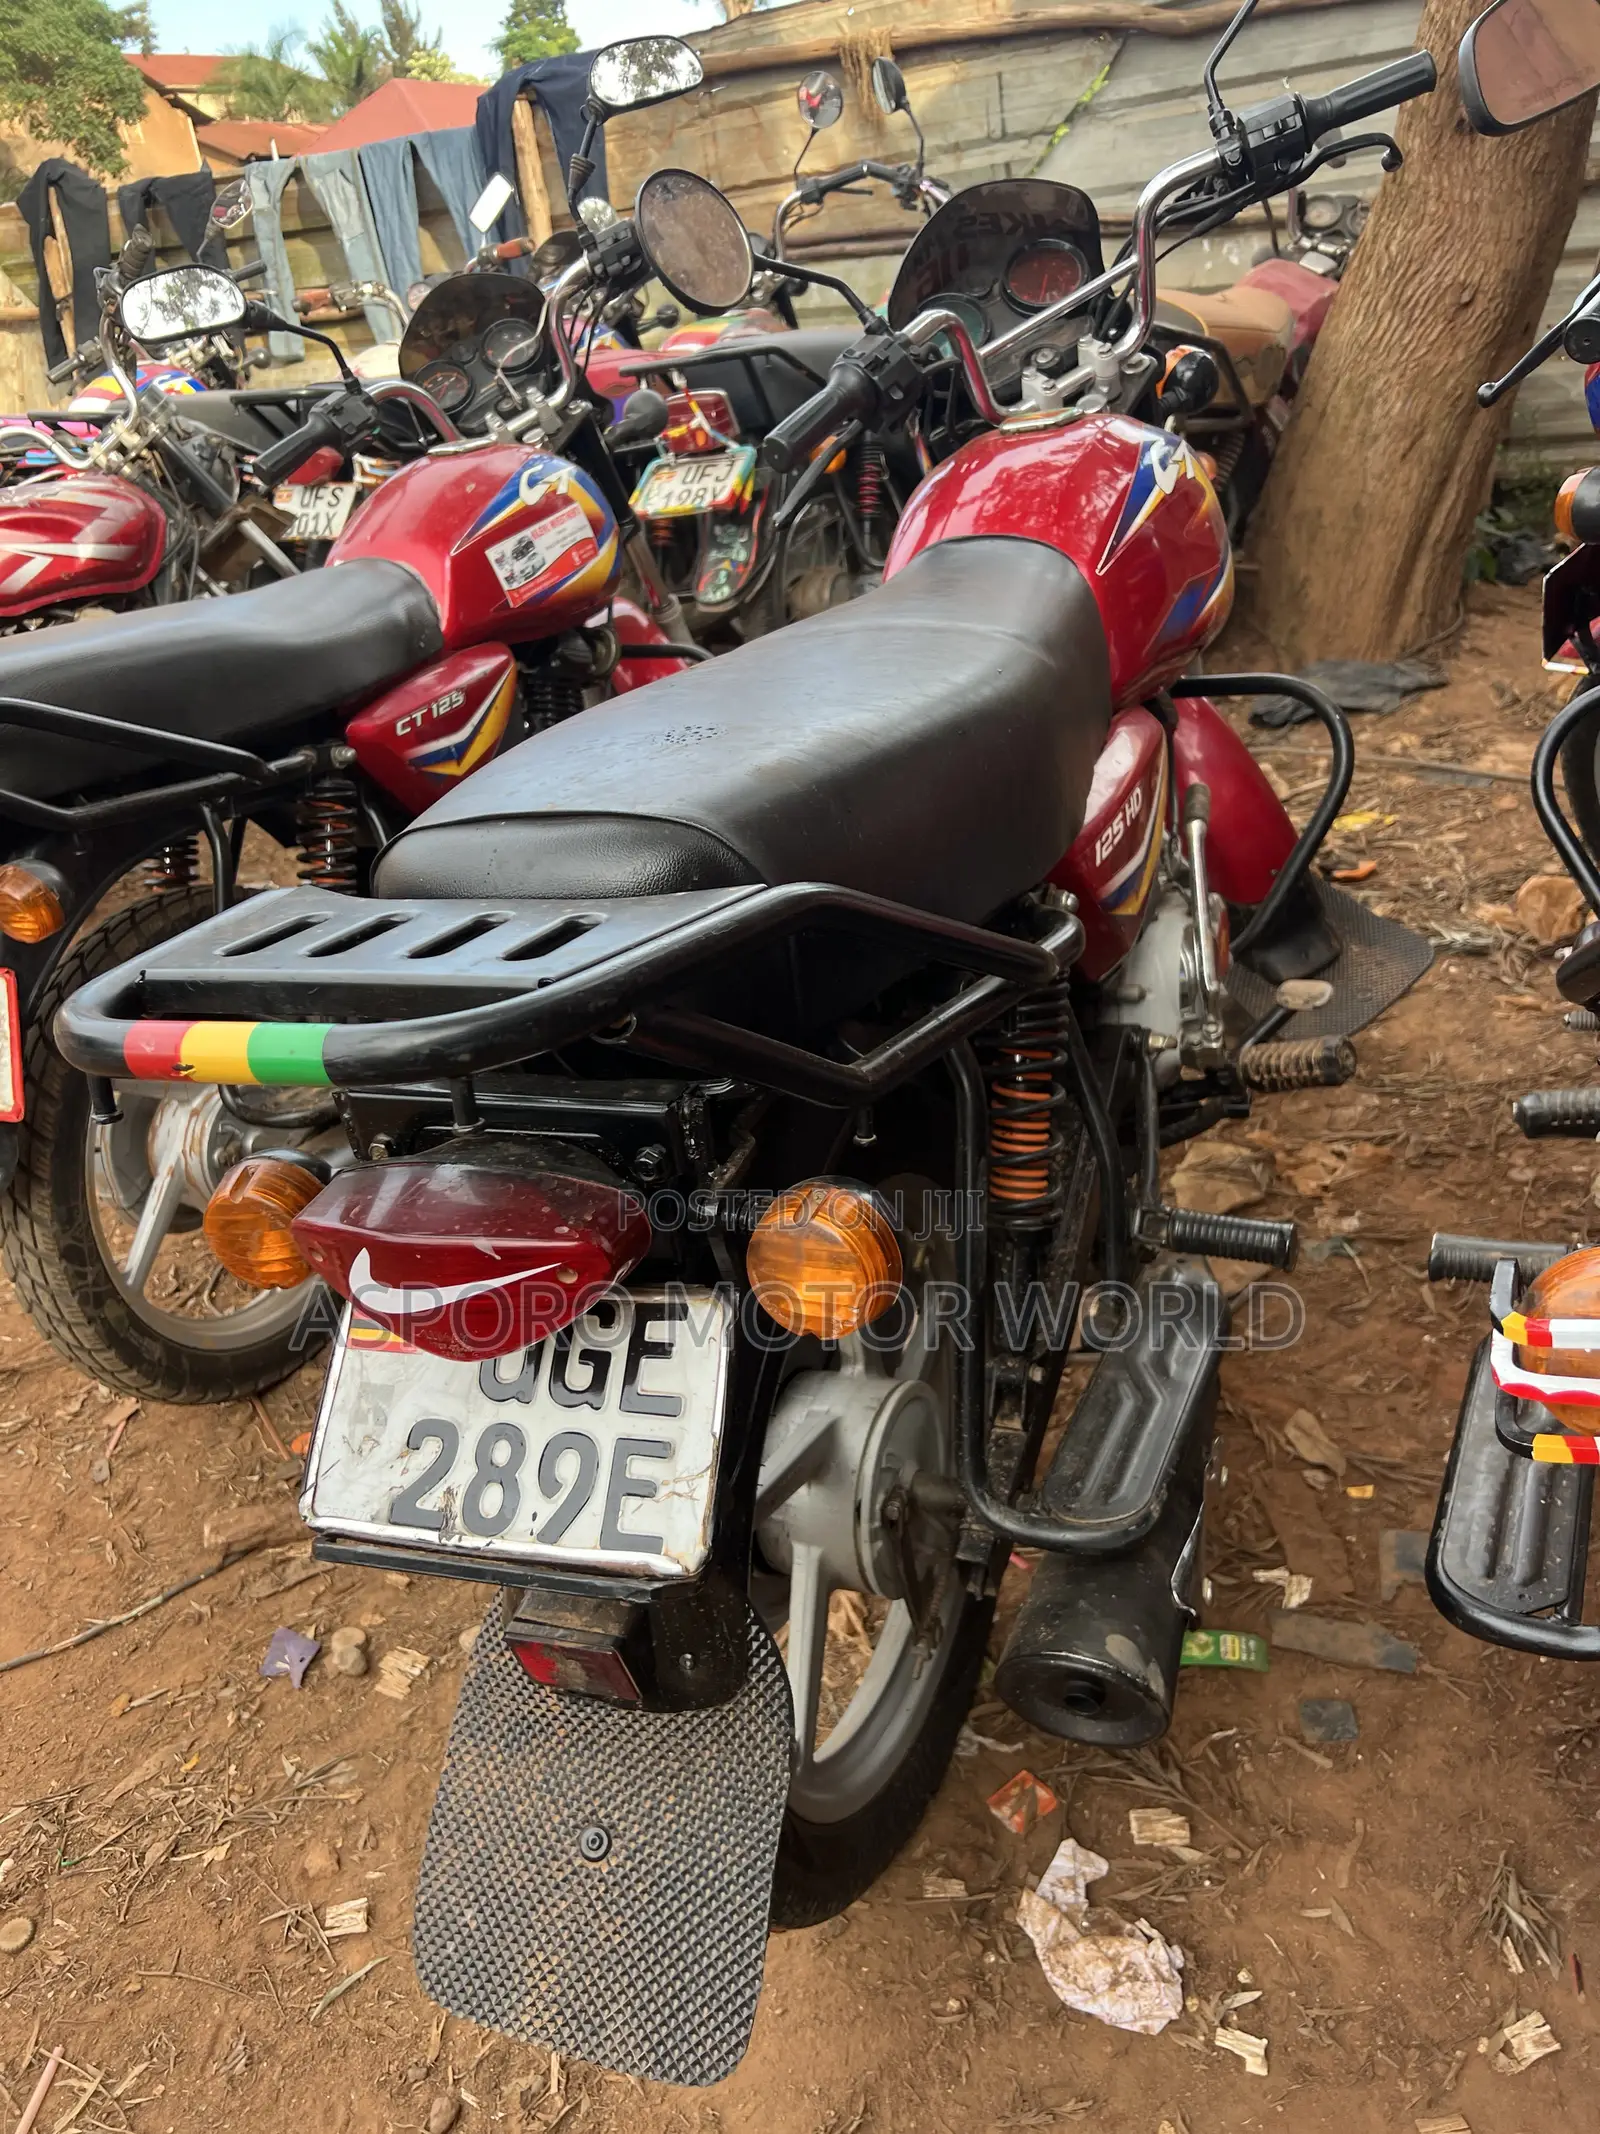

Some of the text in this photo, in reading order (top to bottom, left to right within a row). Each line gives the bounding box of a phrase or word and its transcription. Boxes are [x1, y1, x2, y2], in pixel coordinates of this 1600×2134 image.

[682, 459, 734, 485] UFJ
[300, 486, 344, 508] UFS
[396, 690, 466, 737] CT 125
[1095, 786, 1143, 868] 125 HD
[388, 1418, 674, 1556] 289E
